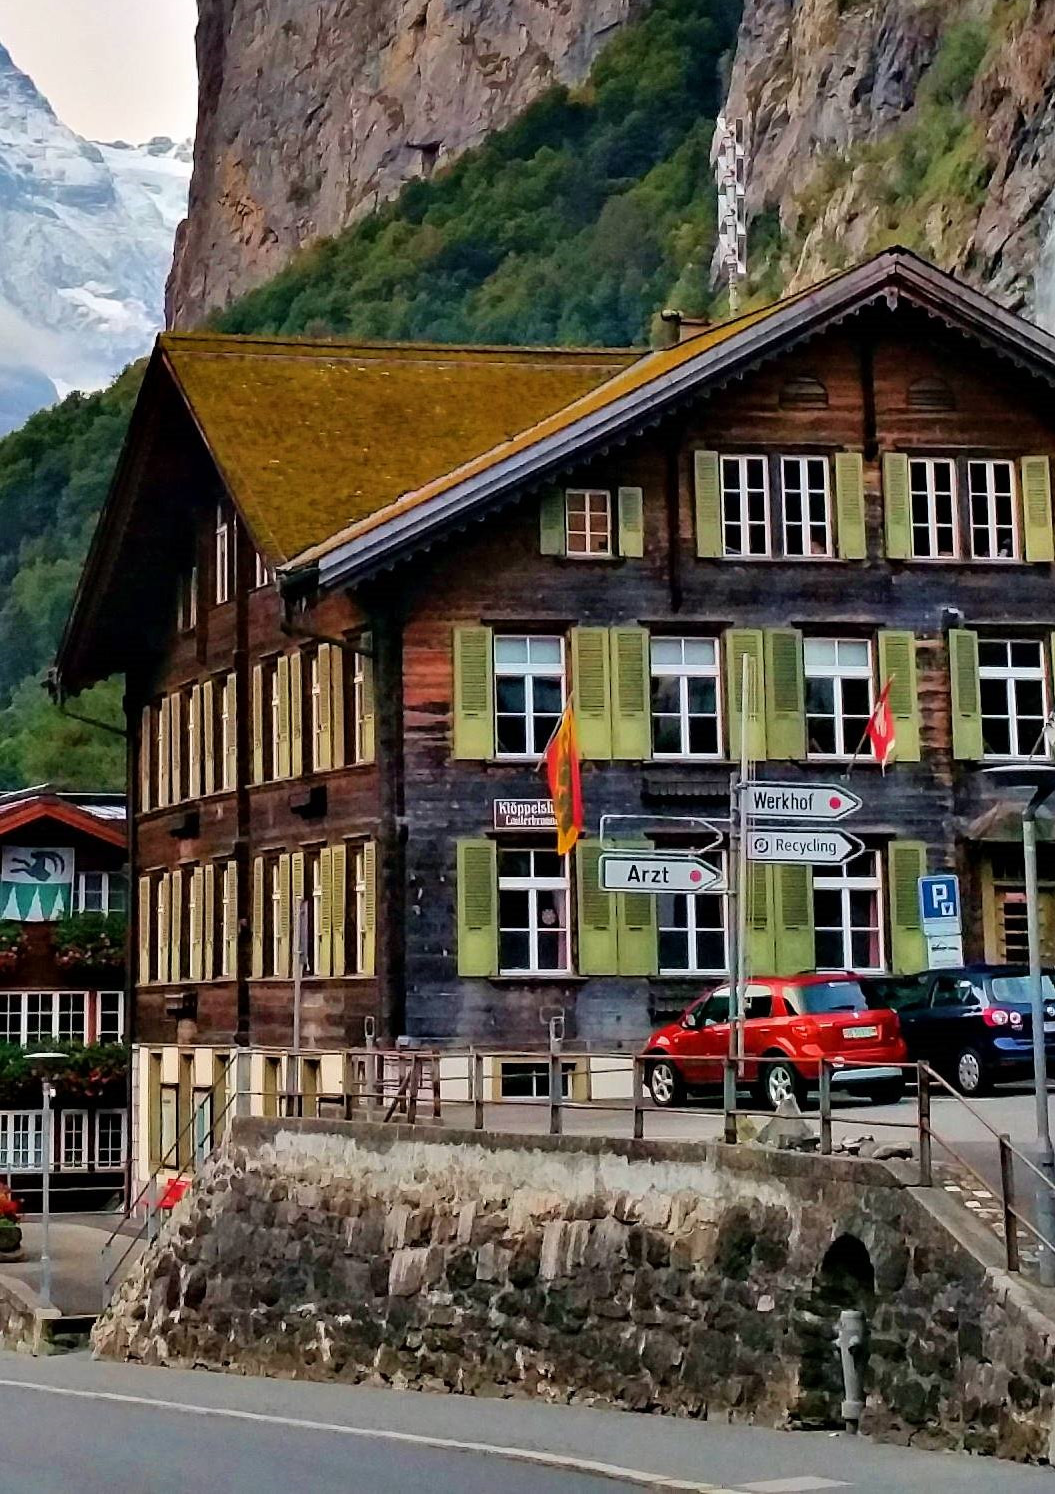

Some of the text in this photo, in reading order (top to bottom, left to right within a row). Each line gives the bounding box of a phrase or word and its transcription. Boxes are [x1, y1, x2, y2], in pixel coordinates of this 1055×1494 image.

[753, 791, 814, 810] Werkhof
[776, 838, 837, 856] Recycling
[627, 864, 670, 884] Arzt
[931, 884, 947, 909] P
